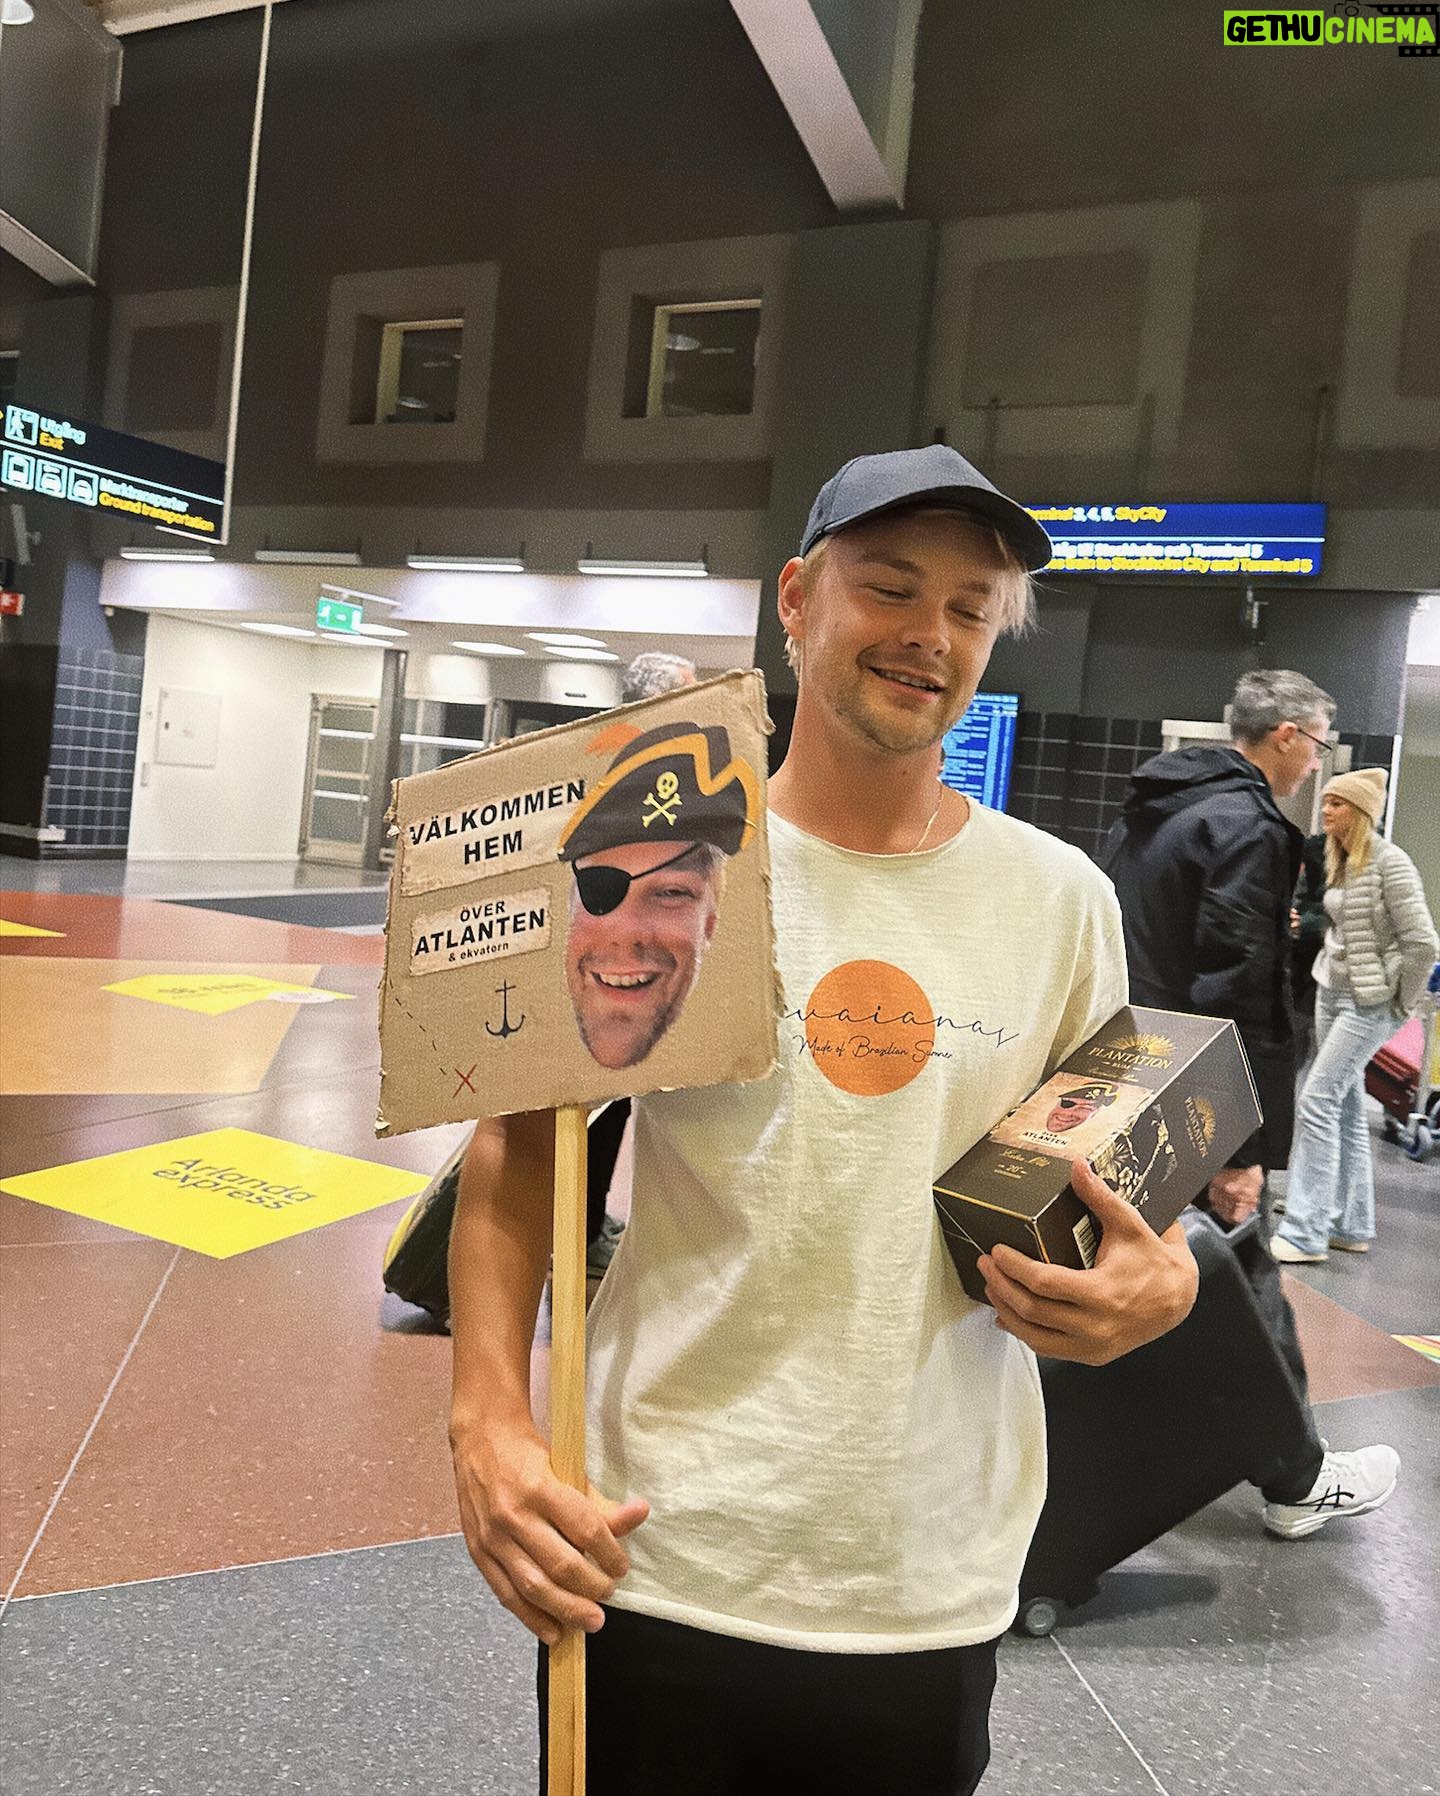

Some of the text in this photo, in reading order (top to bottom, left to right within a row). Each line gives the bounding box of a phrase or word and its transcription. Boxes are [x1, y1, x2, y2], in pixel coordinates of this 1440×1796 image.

[39, 432, 65, 450] Exit
[99, 492, 215, 532] Ground transportation
[1115, 506, 1167, 523] SkyCity
[1094, 543, 1164, 557] Stockholm
[1191, 543, 1250, 557] Terminal
[1251, 544, 1264, 558] 5
[1096, 557, 1111, 570] to
[1111, 557, 1182, 570] Stockholm
[1182, 557, 1211, 573] City
[1210, 558, 1239, 572] and
[1239, 558, 1300, 572] Terminal
[1300, 559, 1313, 573] 5
[410, 779, 585, 845] VÄLKOMMEN
[464, 830, 523, 865] HEM
[460, 901, 505, 922] ÖVER
[414, 908, 545, 956] ATLANTEN
[448, 942, 509, 962] & ekvatorn
[786, 1005, 1019, 1048] vaianas
[792, 1035, 832, 1057] Made
[835, 1041, 845, 1057] of
[848, 1035, 908, 1058] Brazilian
[1088, 1047, 1173, 1069] PLANTATION
[1022, 1131, 1069, 1146] ATLANTEN
[1184, 1096, 1208, 1158] PLANTATION
[153, 1168, 293, 1209] express
[171, 1159, 317, 1201] Arlanda
